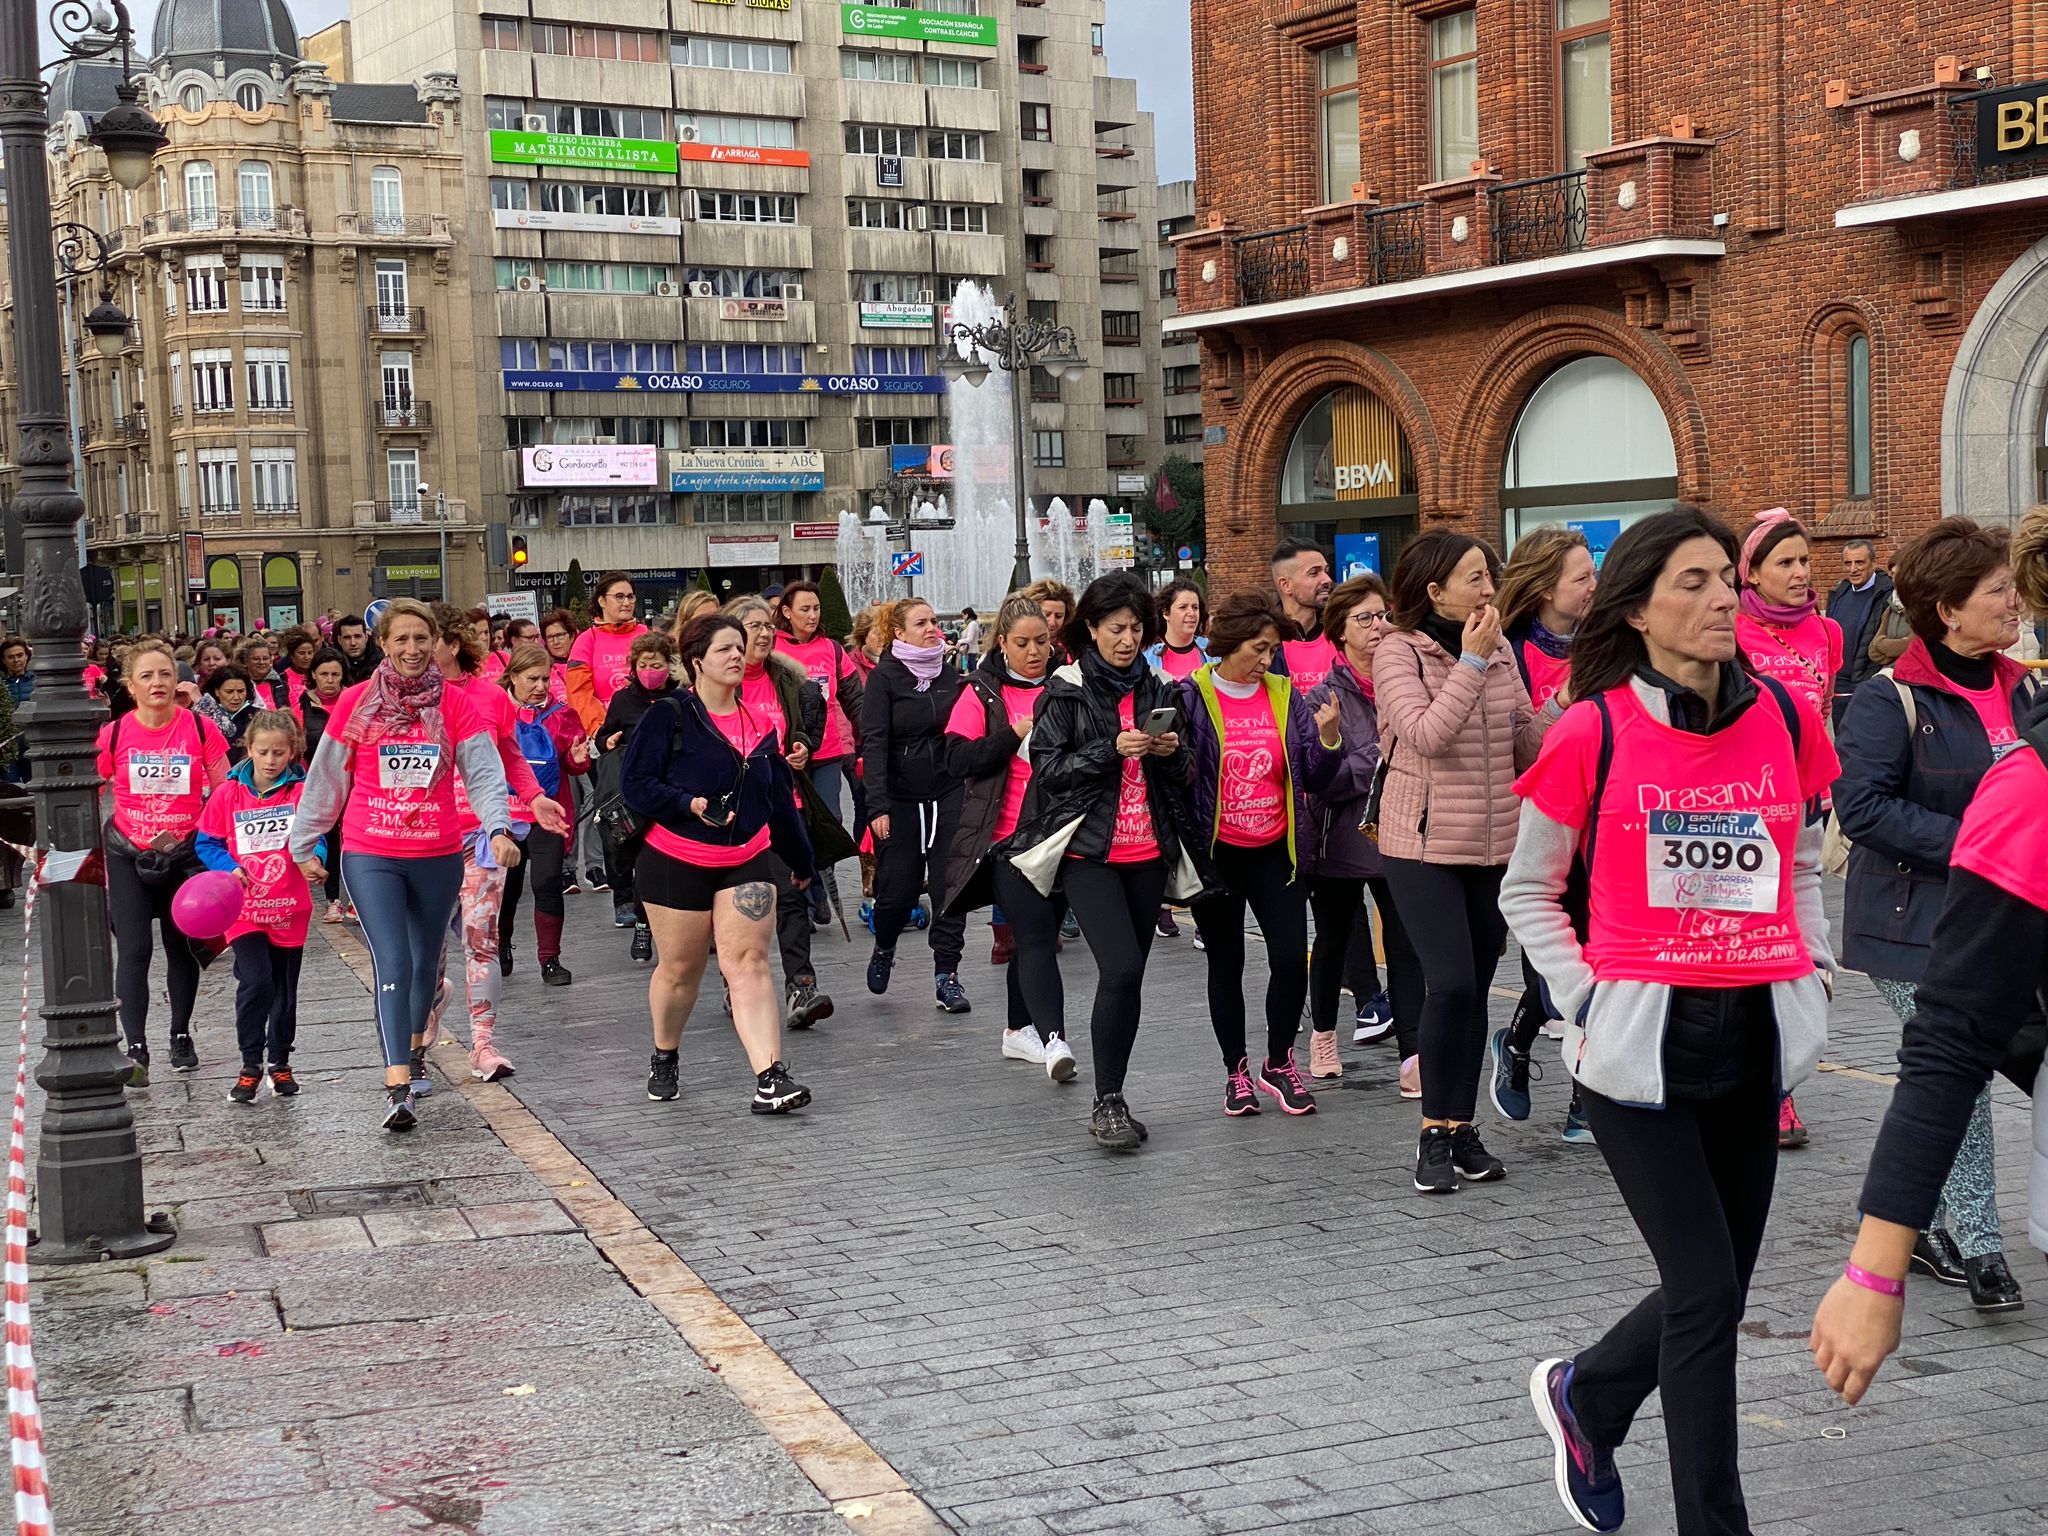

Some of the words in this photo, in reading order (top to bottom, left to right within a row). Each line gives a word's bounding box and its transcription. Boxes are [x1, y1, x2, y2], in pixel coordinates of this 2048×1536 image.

[919, 17, 954, 28] ASOCIACIÓN
[954, 21, 984, 30] ESPAÑOLA
[924, 27, 949, 36] CONTRA
[955, 29, 979, 38] CÁNCER
[547, 136, 577, 145] CHARO
[581, 138, 623, 148] LLAMERA
[514, 142, 660, 162] MATRIMONIALISTA
[726, 148, 760, 159] ARRIAGA
[886, 304, 926, 314] Abogados
[511, 380, 564, 388] www.ocaso.es
[647, 375, 702, 389] OCASO
[708, 380, 751, 390] SEGUROS
[828, 377, 879, 391] OCASO
[883, 381, 923, 391] SEGUROS
[681, 455, 693, 468] La
[695, 456, 726, 468] Nueva
[727, 455, 765, 468] Crónica
[790, 455, 818, 467] ABC
[1335, 459, 1394, 490] BBVA
[675, 475, 687, 486] La
[690, 477, 712, 490] mejor
[713, 475, 740, 489] oferta
[741, 475, 788, 487] informativa
[790, 475, 800, 485] de
[802, 474, 822, 486] León
[515, 573, 552, 587] librería
[554, 571, 600, 586] PAOR
[649, 570, 677, 578] House
[496, 595, 527, 603] ATENCIÓN
[1751, 648, 1826, 669] Drasavi
[1225, 711, 1269, 728] asanvi
[388, 757, 432, 770] 0724
[1638, 764, 1777, 813] Drasanvi
[387, 801, 440, 812] CARRERA
[1228, 796, 1279, 811] CARRERA
[144, 813, 192, 823] CARRERA
[1222, 812, 1271, 828] Mujer
[1689, 814, 1739, 824] GRUPO
[244, 818, 288, 836] 0723
[1663, 840, 1763, 872] 3090
[1714, 874, 1753, 884] CARRERA
[1711, 883, 1744, 898] Mujer
[244, 897, 298, 909] CARRERA
[1726, 943, 1797, 963] DRASANVI
